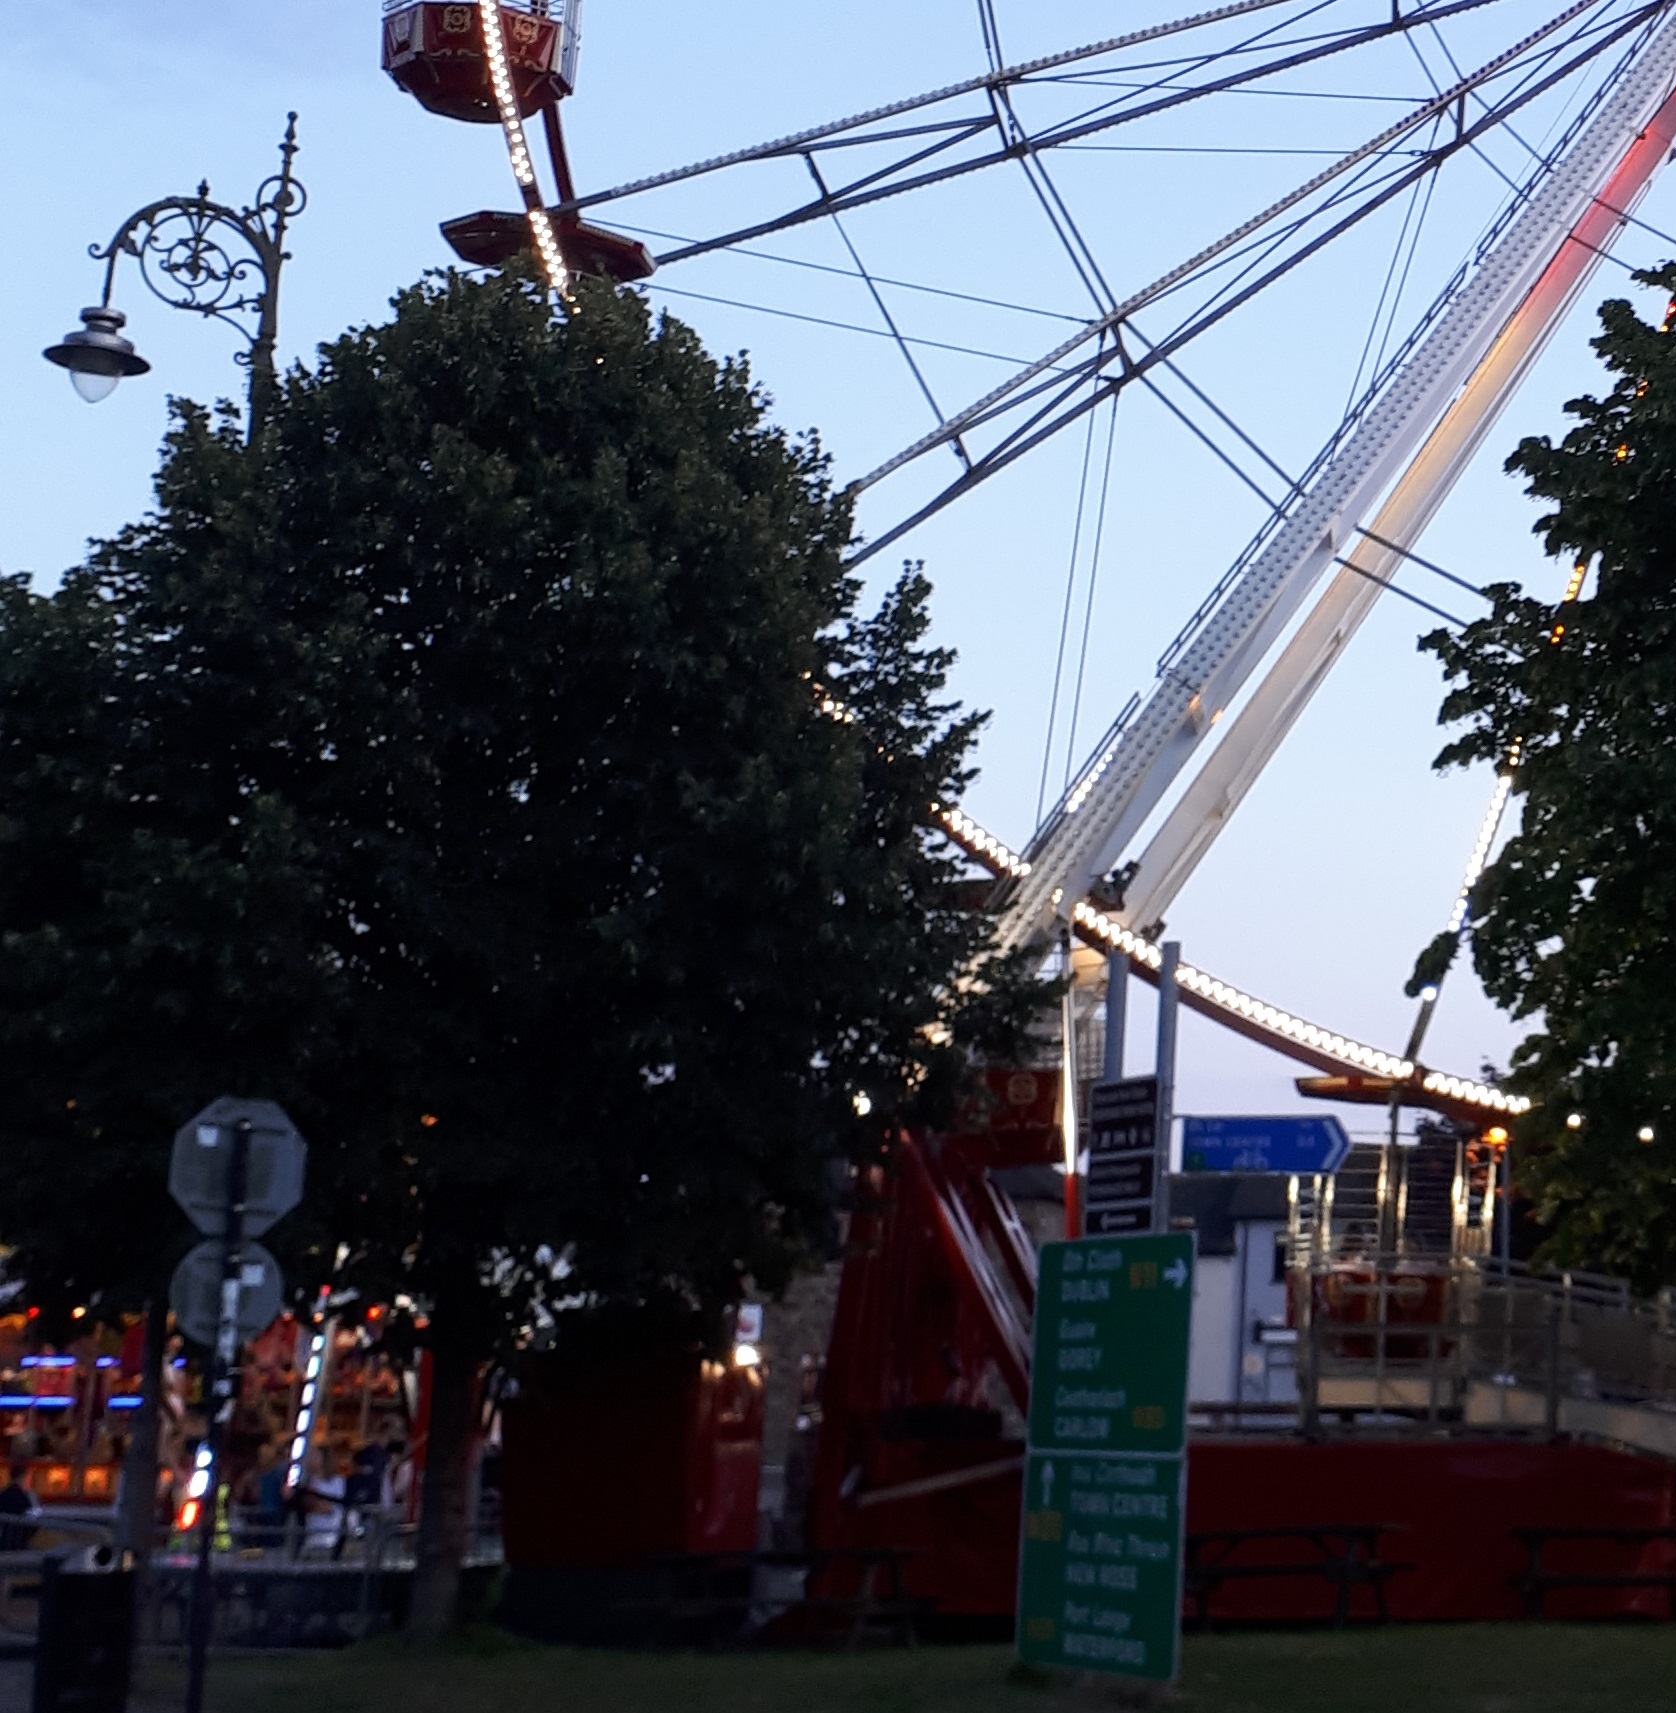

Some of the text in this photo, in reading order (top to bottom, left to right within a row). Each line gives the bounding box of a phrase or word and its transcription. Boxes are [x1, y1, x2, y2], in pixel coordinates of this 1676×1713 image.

[1225, 1136, 1271, 1148] CENTRE
[1061, 1278, 1110, 1302] DUBLIN
[1054, 1415, 1110, 1438] CARLOW
[1071, 1489, 1168, 1519] TOWN CENTRE
[1099, 1564, 1138, 1590] ROSS
